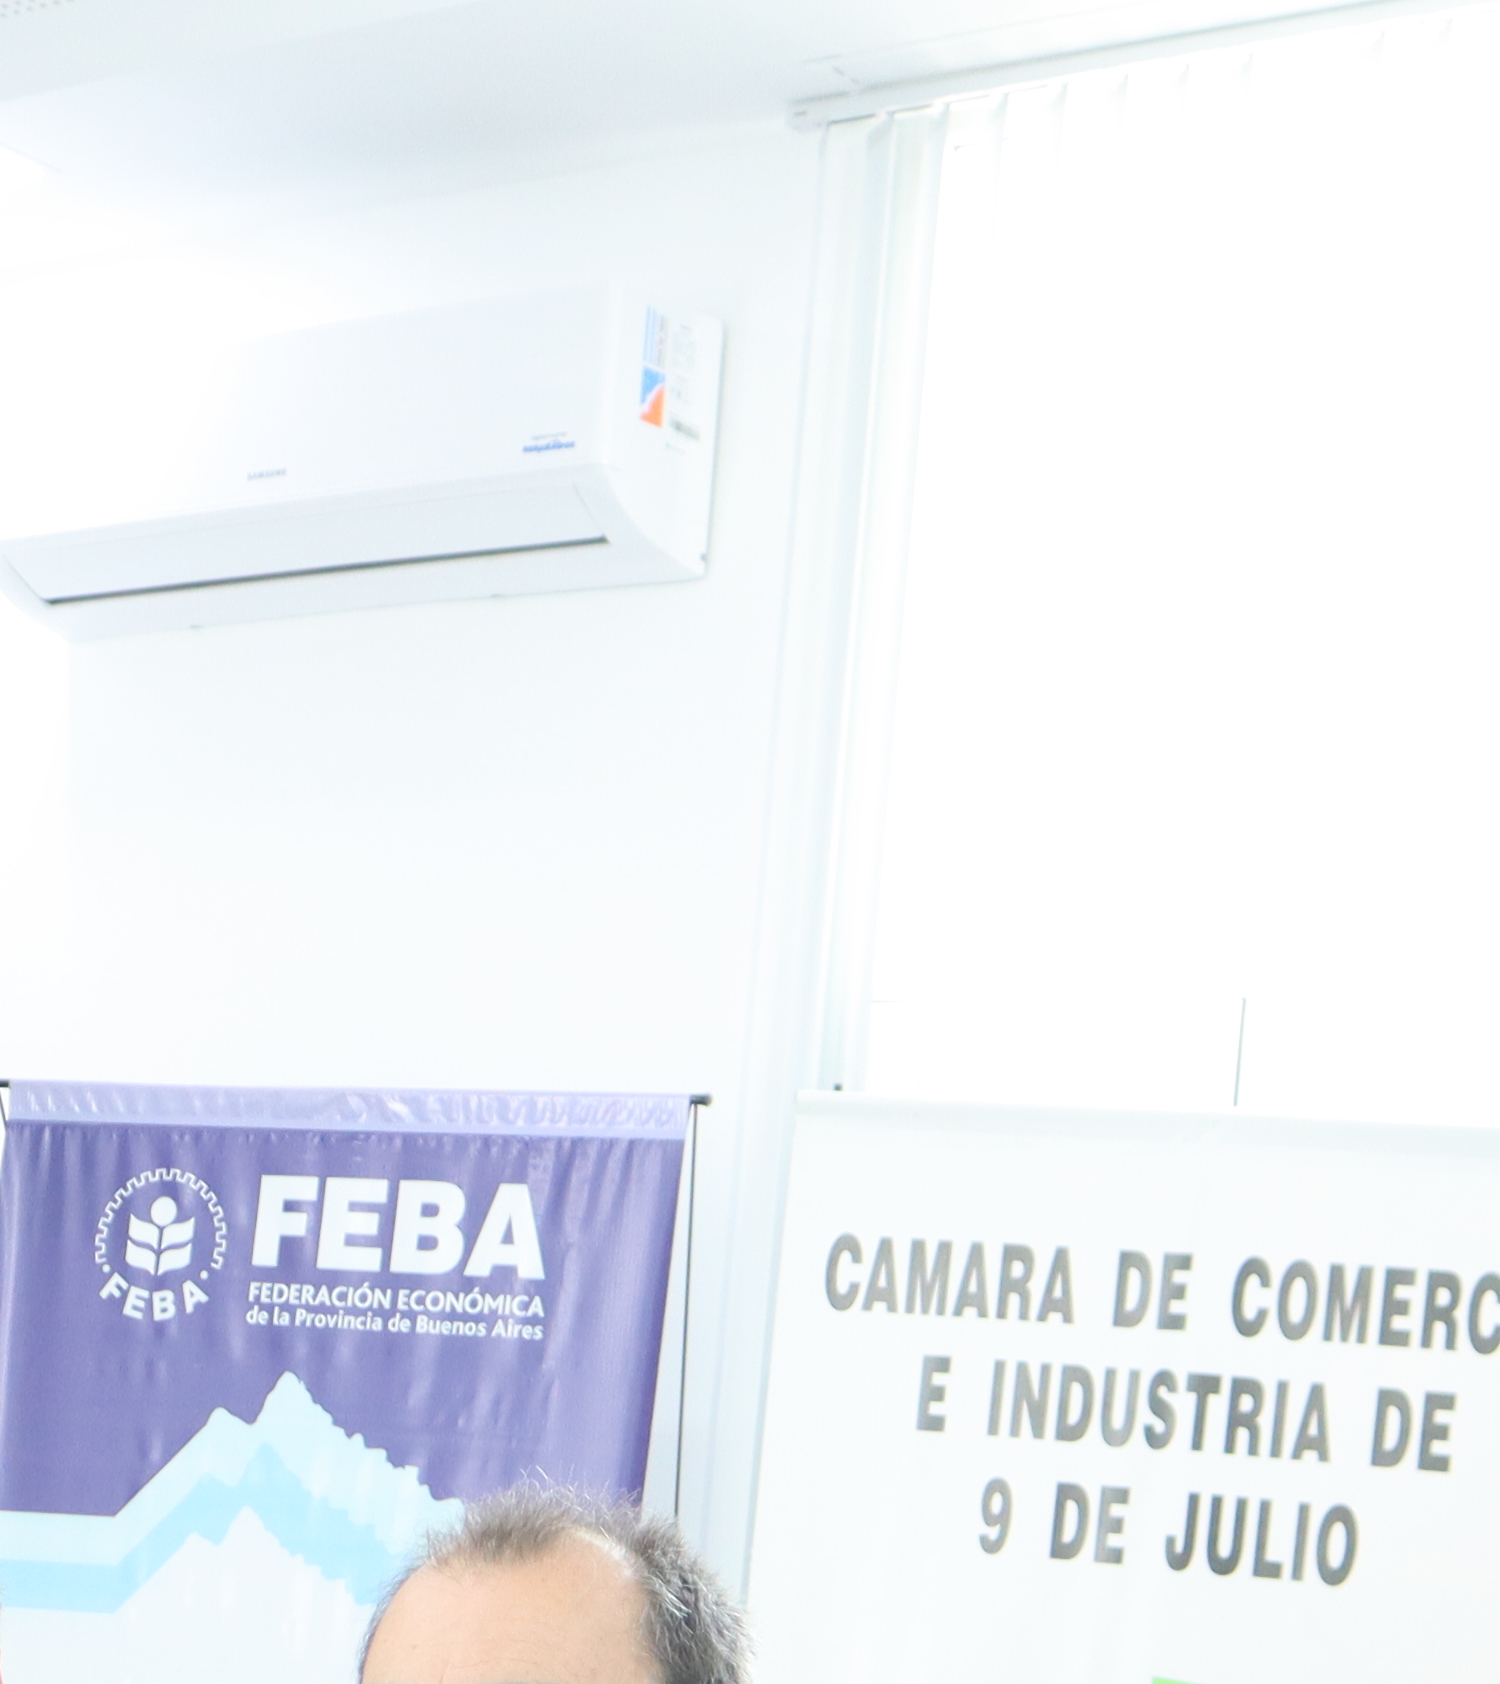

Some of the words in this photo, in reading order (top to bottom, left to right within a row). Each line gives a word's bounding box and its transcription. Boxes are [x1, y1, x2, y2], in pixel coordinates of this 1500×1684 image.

[252, 1174, 546, 1281] FEBA
[99, 1271, 210, 1322] FEBA
[246, 1305, 269, 1326] de
[272, 1306, 291, 1327] la
[294, 1308, 384, 1332] Provincia
[388, 1311, 412, 1334] de
[415, 1315, 488, 1338] Buenos
[490, 1317, 545, 1341] Aires
[248, 1281, 393, 1310] FEDERACIÓN
[397, 1286, 546, 1319] ECONÓMICA
[825, 1232, 1075, 1325] CAMARA
[1112, 1249, 1194, 1332] DE
[916, 1354, 953, 1433] E
[987, 1358, 1331, 1464] INDUSTRIA
[1370, 1386, 1457, 1473] DE
[979, 1476, 1013, 1556] 9
[1048, 1481, 1130, 1565] DE
[1164, 1491, 1358, 1588] JULIO
